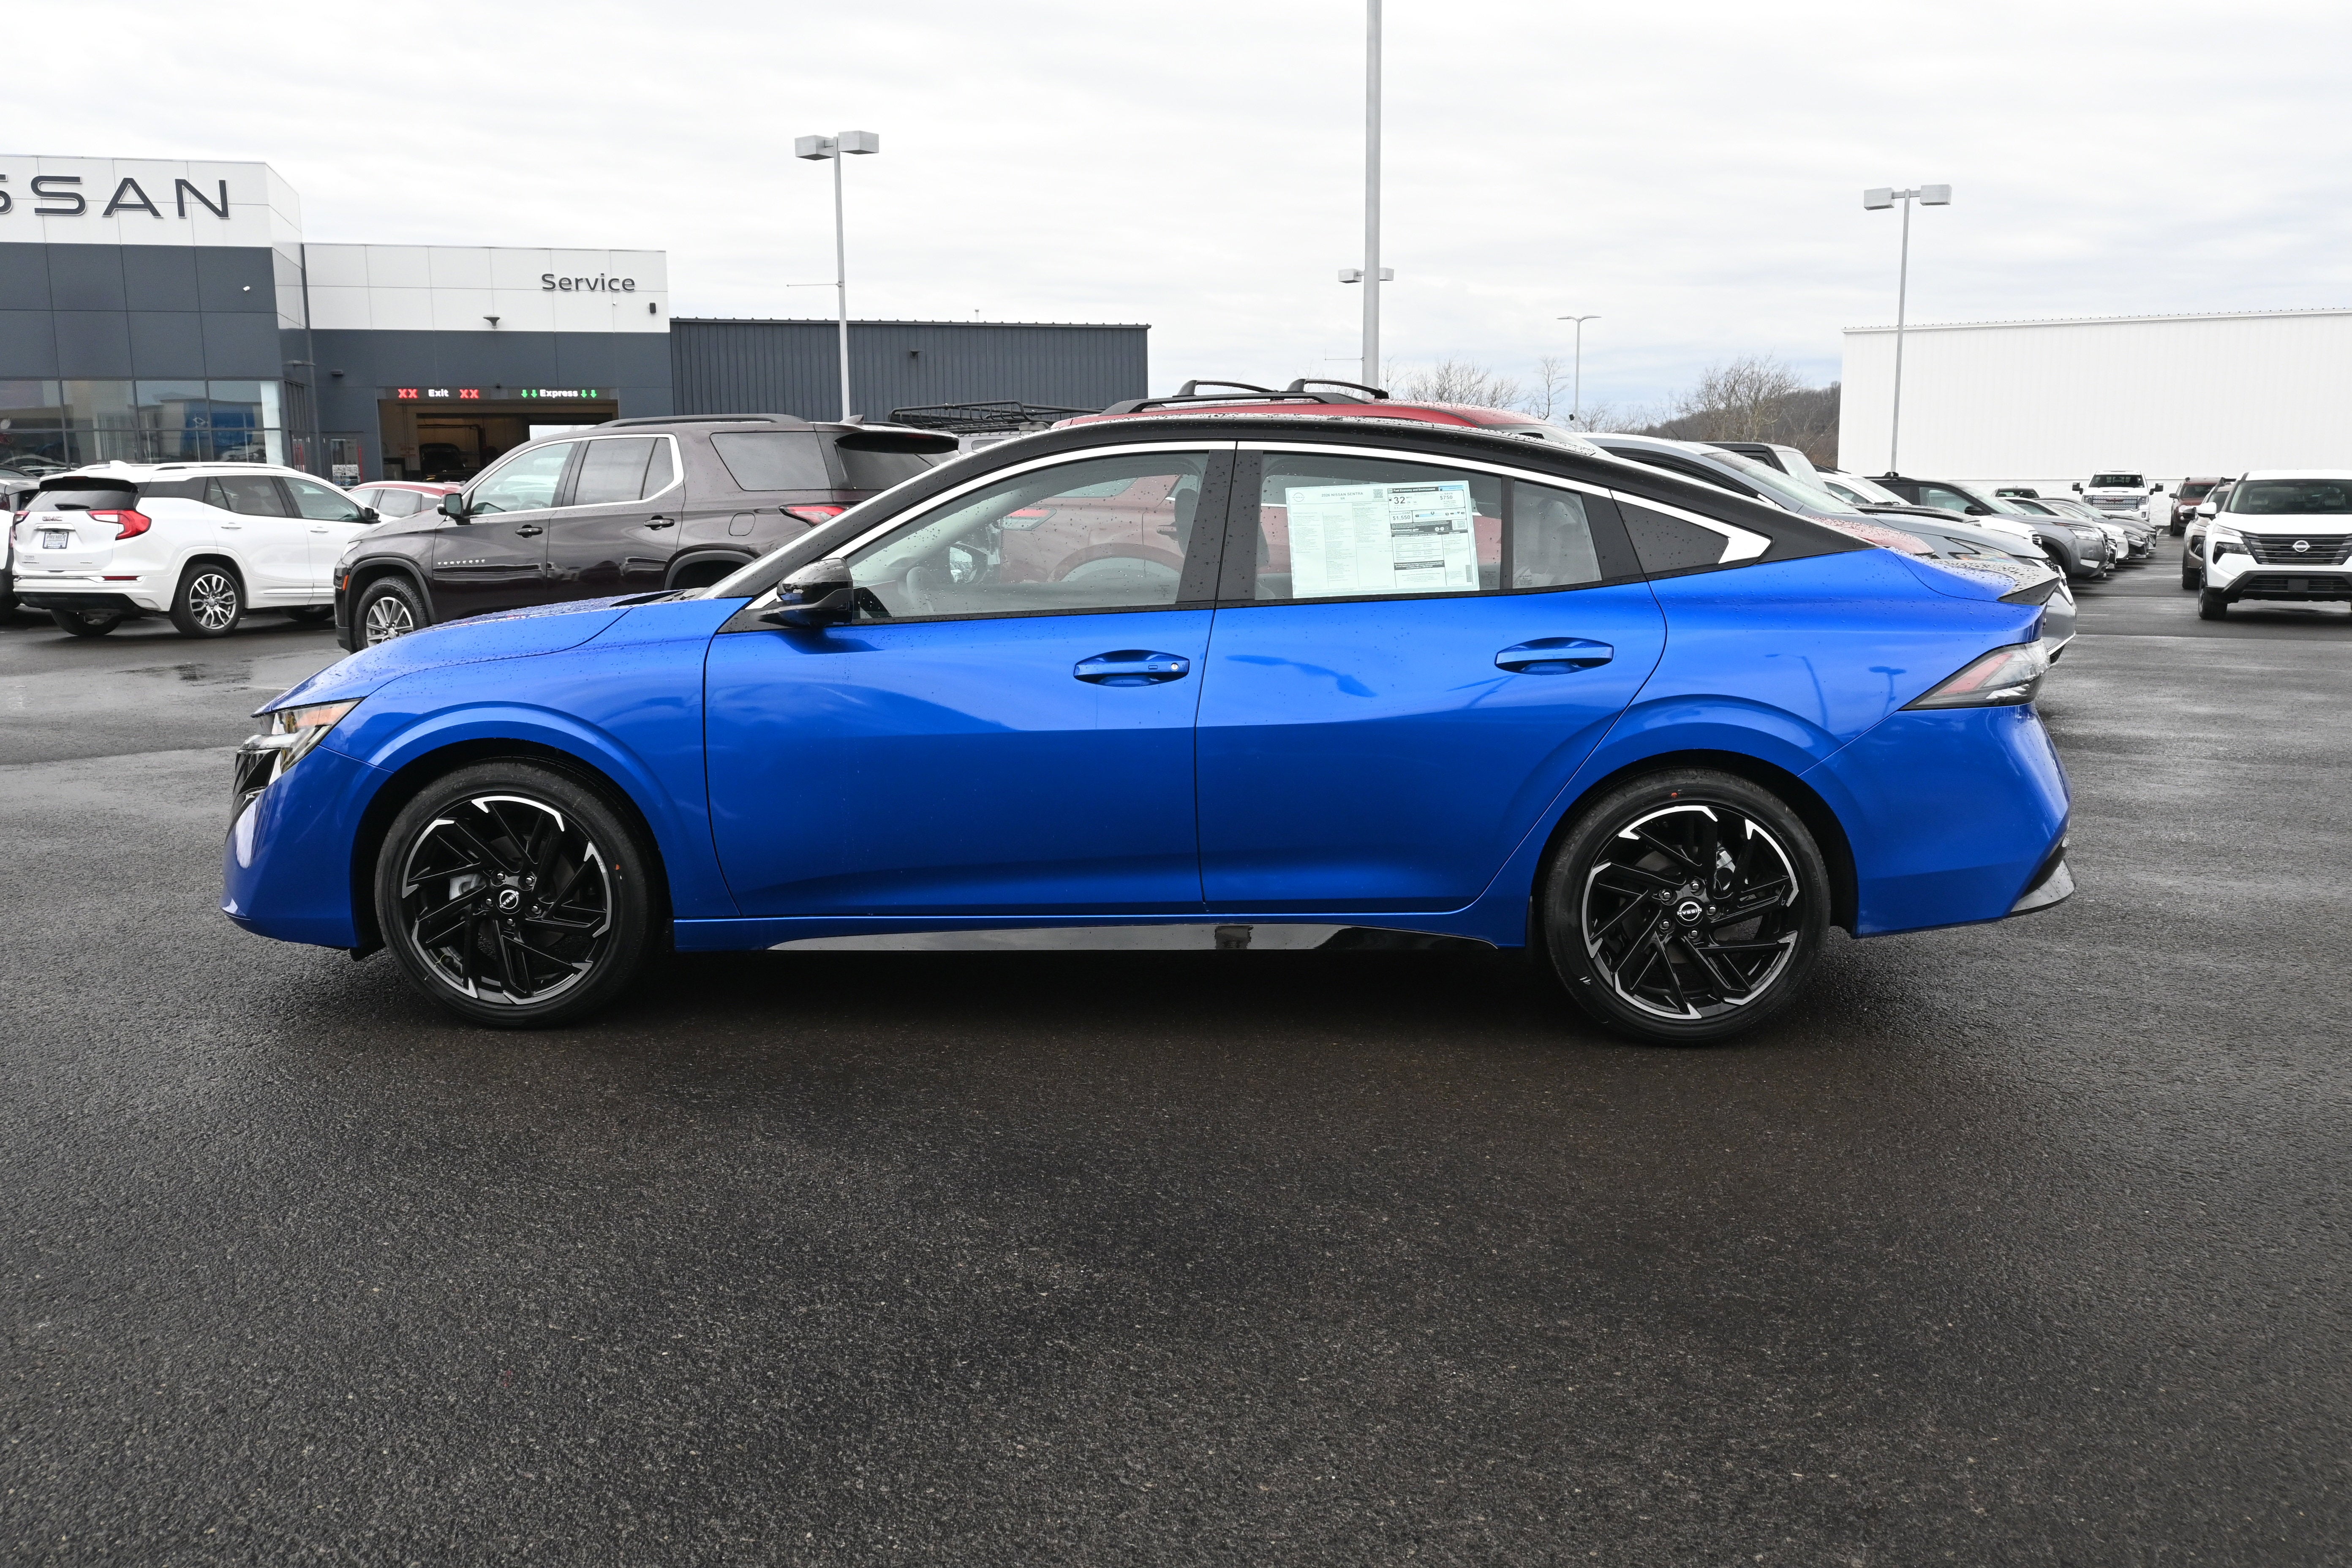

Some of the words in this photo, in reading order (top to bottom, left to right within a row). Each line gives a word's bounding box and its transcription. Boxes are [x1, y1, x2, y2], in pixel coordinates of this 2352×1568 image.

[0, 174, 230, 219] SAN
[541, 273, 635, 292] Service
[428, 389, 449, 397] Exit
[539, 389, 578, 398] Express
[499, 891, 520, 908] NISSAN
[1677, 907, 1702, 915] NISSAN
